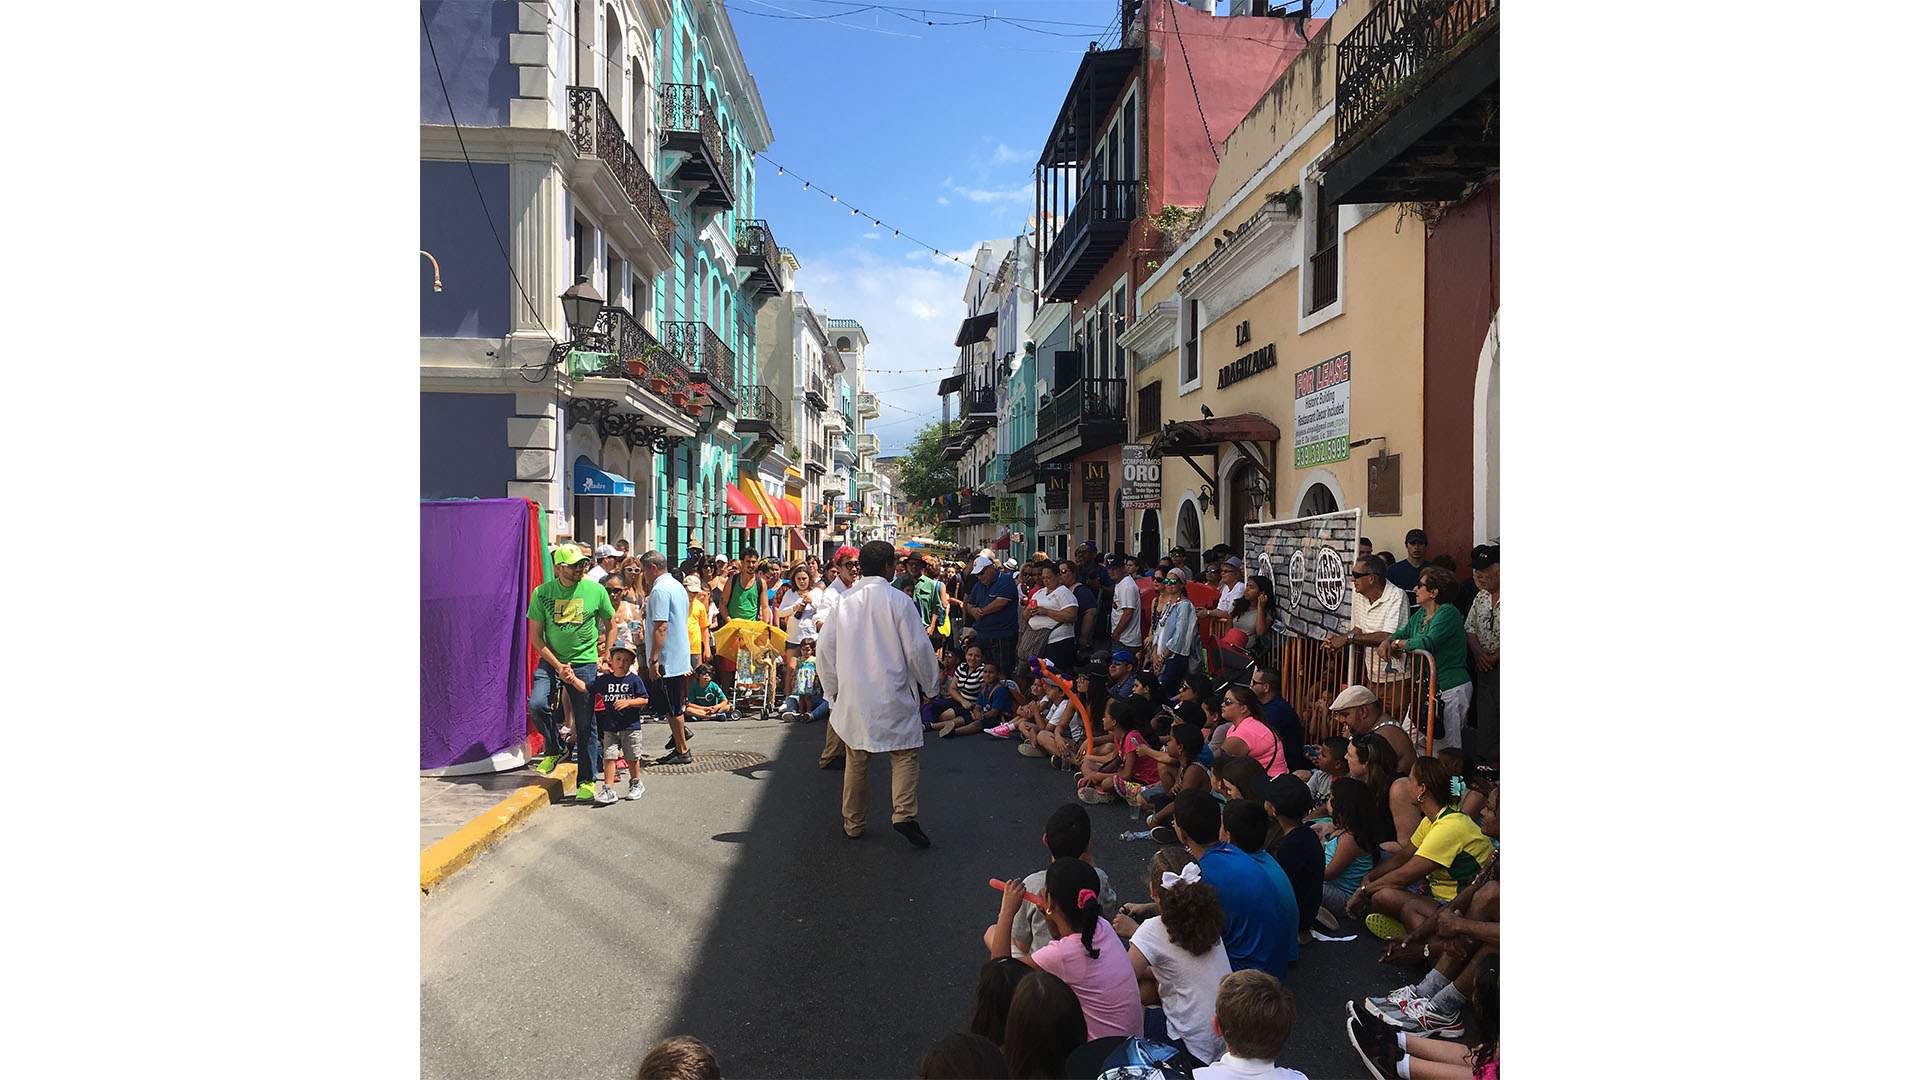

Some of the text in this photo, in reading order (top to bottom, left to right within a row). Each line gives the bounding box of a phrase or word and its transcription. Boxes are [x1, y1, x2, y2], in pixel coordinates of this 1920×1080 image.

[1235, 320, 1251, 347] LA
[1296, 354, 1349, 399] FOR LEASE
[1122, 458, 1161, 466] COMPRAMOS
[1124, 464, 1160, 481] ORO
[1317, 580, 1343, 606] FEST
[607, 683, 630, 693] BIG
